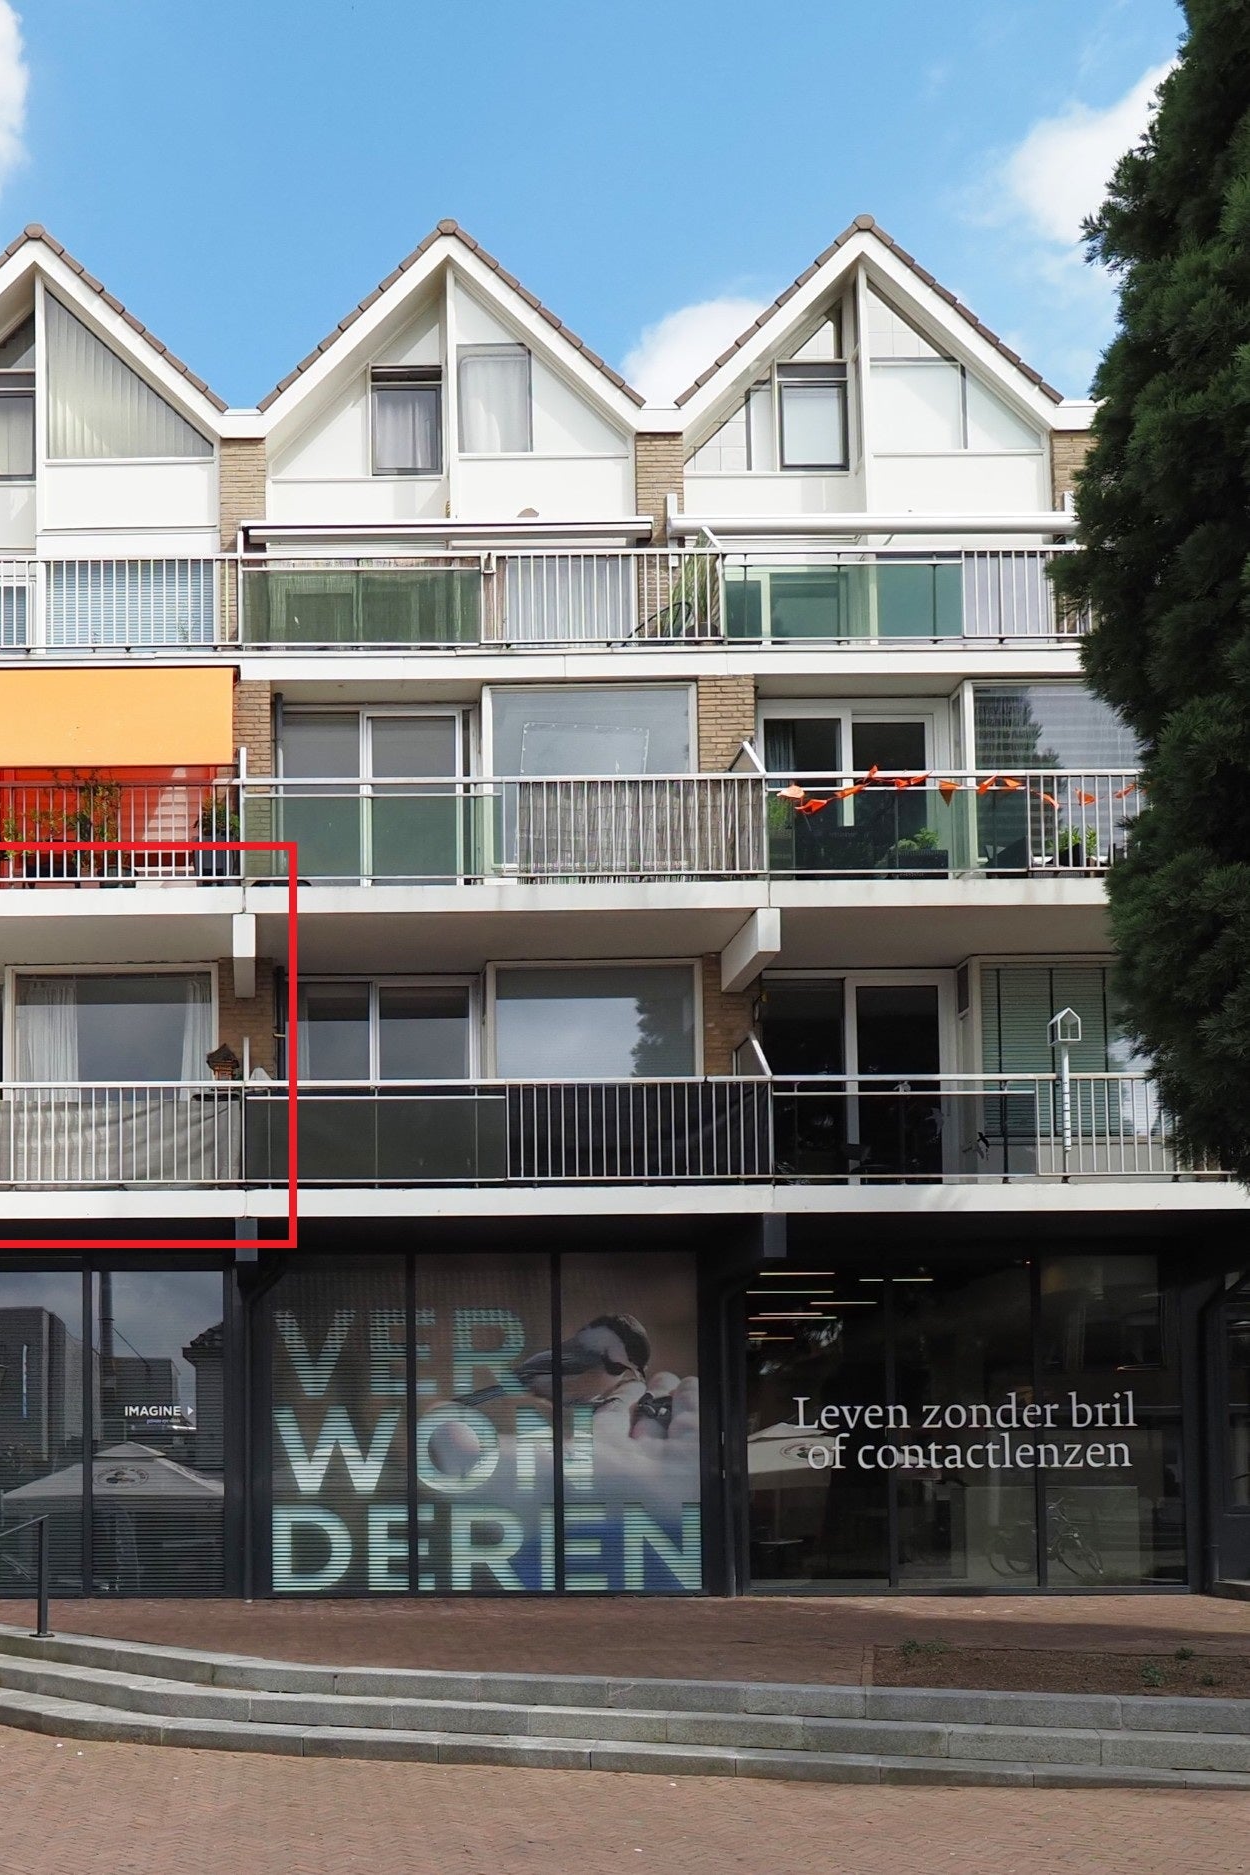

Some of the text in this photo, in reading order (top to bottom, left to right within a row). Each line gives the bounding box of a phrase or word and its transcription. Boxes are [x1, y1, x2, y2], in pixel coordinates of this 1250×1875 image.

[272, 1308, 528, 1397] VER
[124, 1406, 181, 1416] IMAGINE
[792, 1390, 1139, 1430] Leven zonder bril
[272, 1401, 595, 1495] WON
[807, 1432, 1133, 1470] of contactlenzen
[272, 1502, 703, 1592] DEREN
